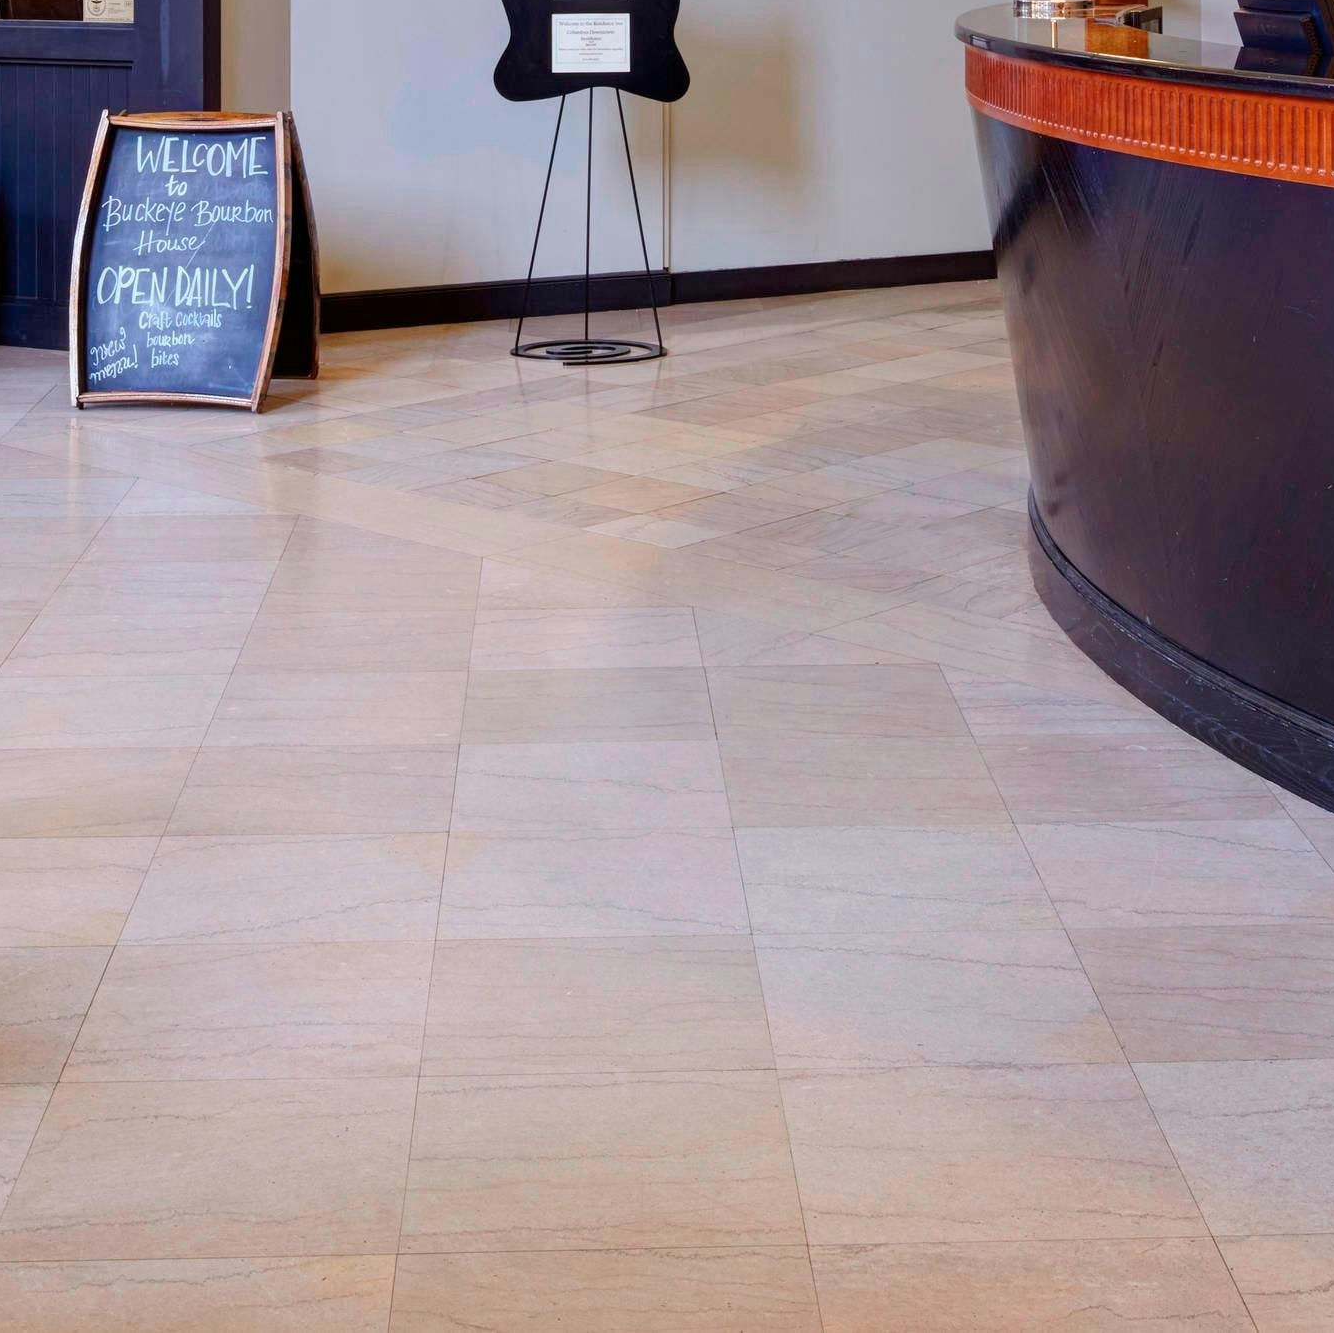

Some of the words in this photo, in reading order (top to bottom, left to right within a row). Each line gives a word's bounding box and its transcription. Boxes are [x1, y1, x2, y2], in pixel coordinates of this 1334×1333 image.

[136, 135, 269, 179] WELCOME
[165, 174, 188, 197] to
[101, 195, 187, 236] Buckeye
[191, 199, 274, 227] Bourbon
[132, 229, 207, 256] House
[96, 266, 168, 306] OPEN
[175, 264, 255, 310] DAILY!
[146, 330, 196, 348] bourbon
[150, 347, 180, 369] bites
